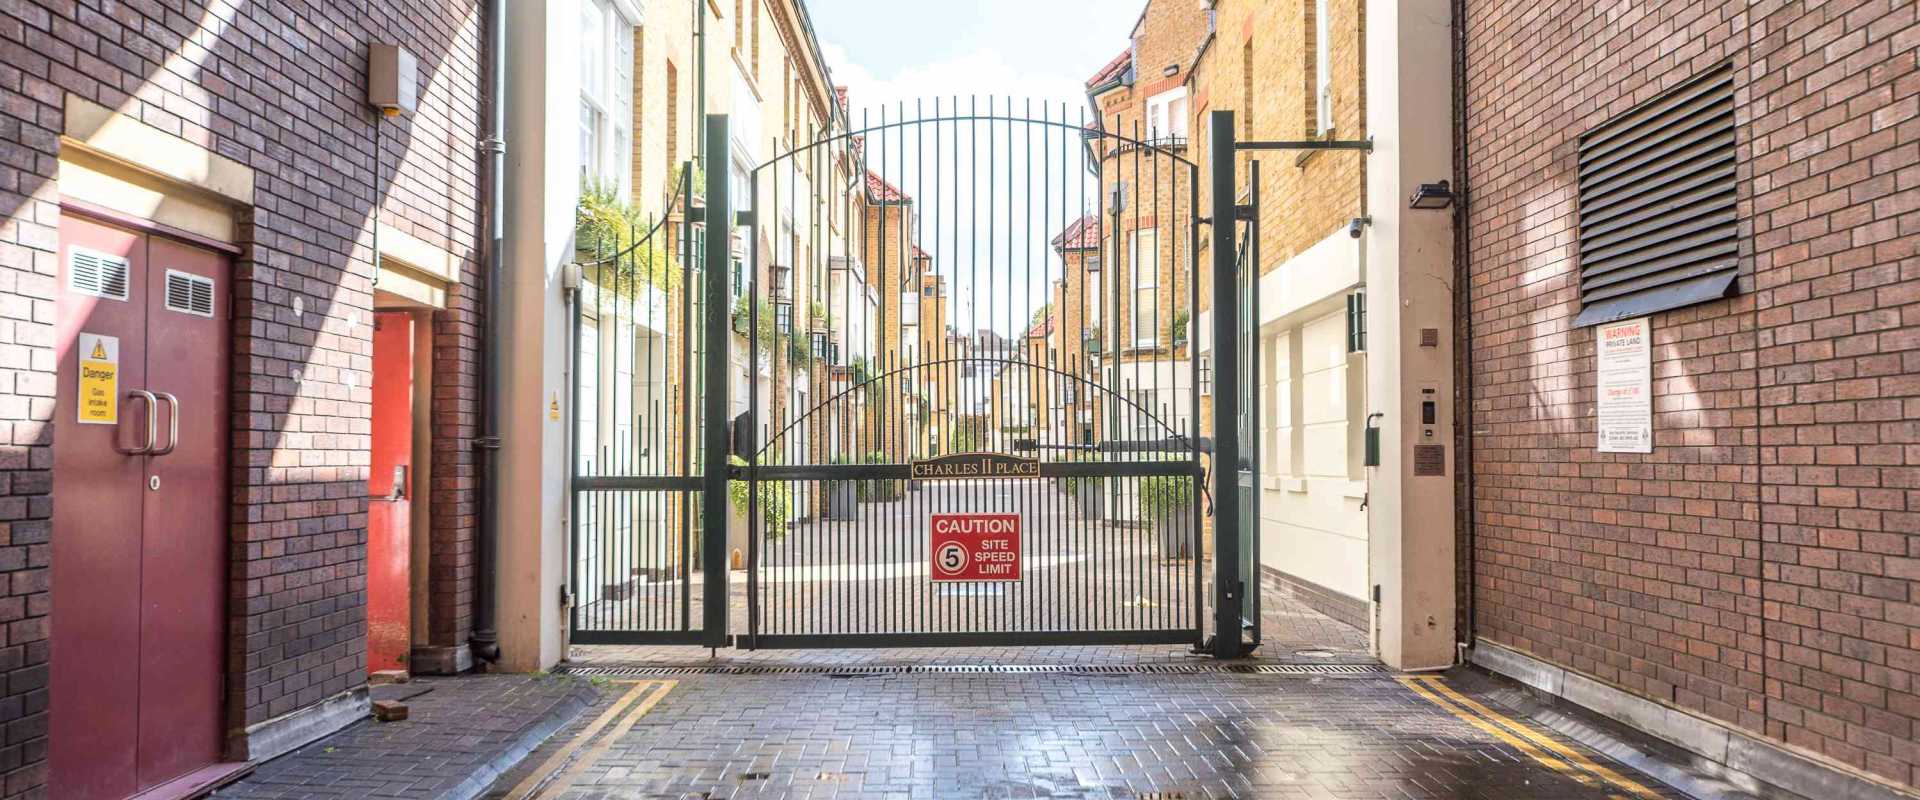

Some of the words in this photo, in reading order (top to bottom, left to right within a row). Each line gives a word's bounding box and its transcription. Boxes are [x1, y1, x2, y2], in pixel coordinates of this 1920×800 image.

[1605, 325, 1640, 339] WARNING
[1626, 337, 1641, 346] LAND
[83, 366, 114, 381] Danger
[92, 388, 104, 397] Gas
[914, 463, 978, 475] CHARLES
[982, 459, 992, 475] II
[996, 462, 1037, 474] PLACE
[936, 519, 1015, 533] CAUTION
[981, 539, 1009, 550] SITE
[945, 548, 959, 567] 5
[975, 551, 1015, 562] SPEED
[979, 563, 1012, 574] LIMIT
